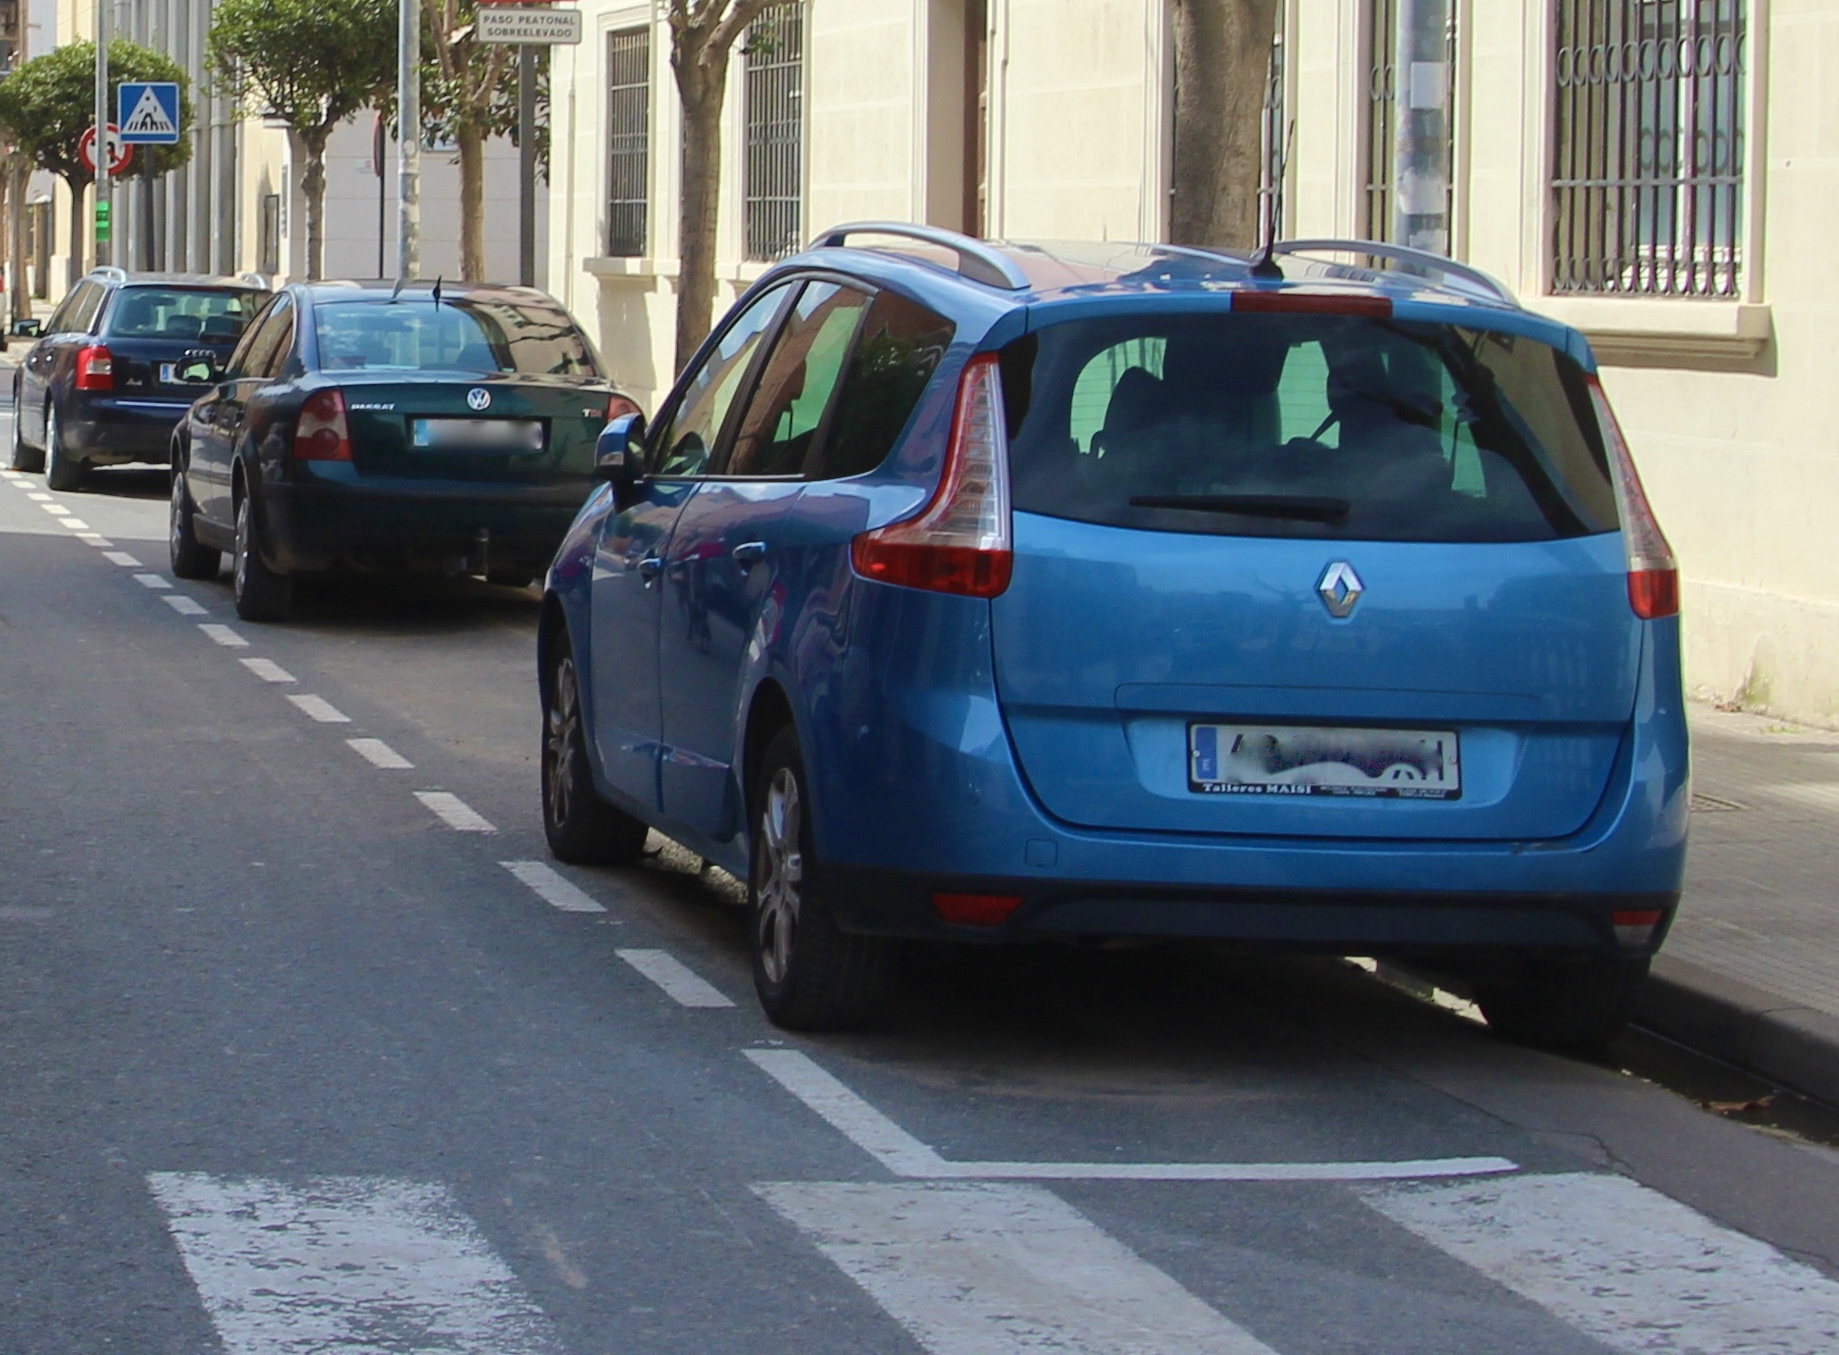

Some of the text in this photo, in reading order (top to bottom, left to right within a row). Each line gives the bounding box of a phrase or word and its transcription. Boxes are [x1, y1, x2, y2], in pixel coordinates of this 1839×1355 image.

[483, 15, 576, 26] PASO PEATONAL
[486, 27, 573, 38] SOBREELEVADO
[582, 408, 602, 418] TDI
[1202, 782, 1263, 794] Talleres
[1266, 784, 1312, 795] MAISI
